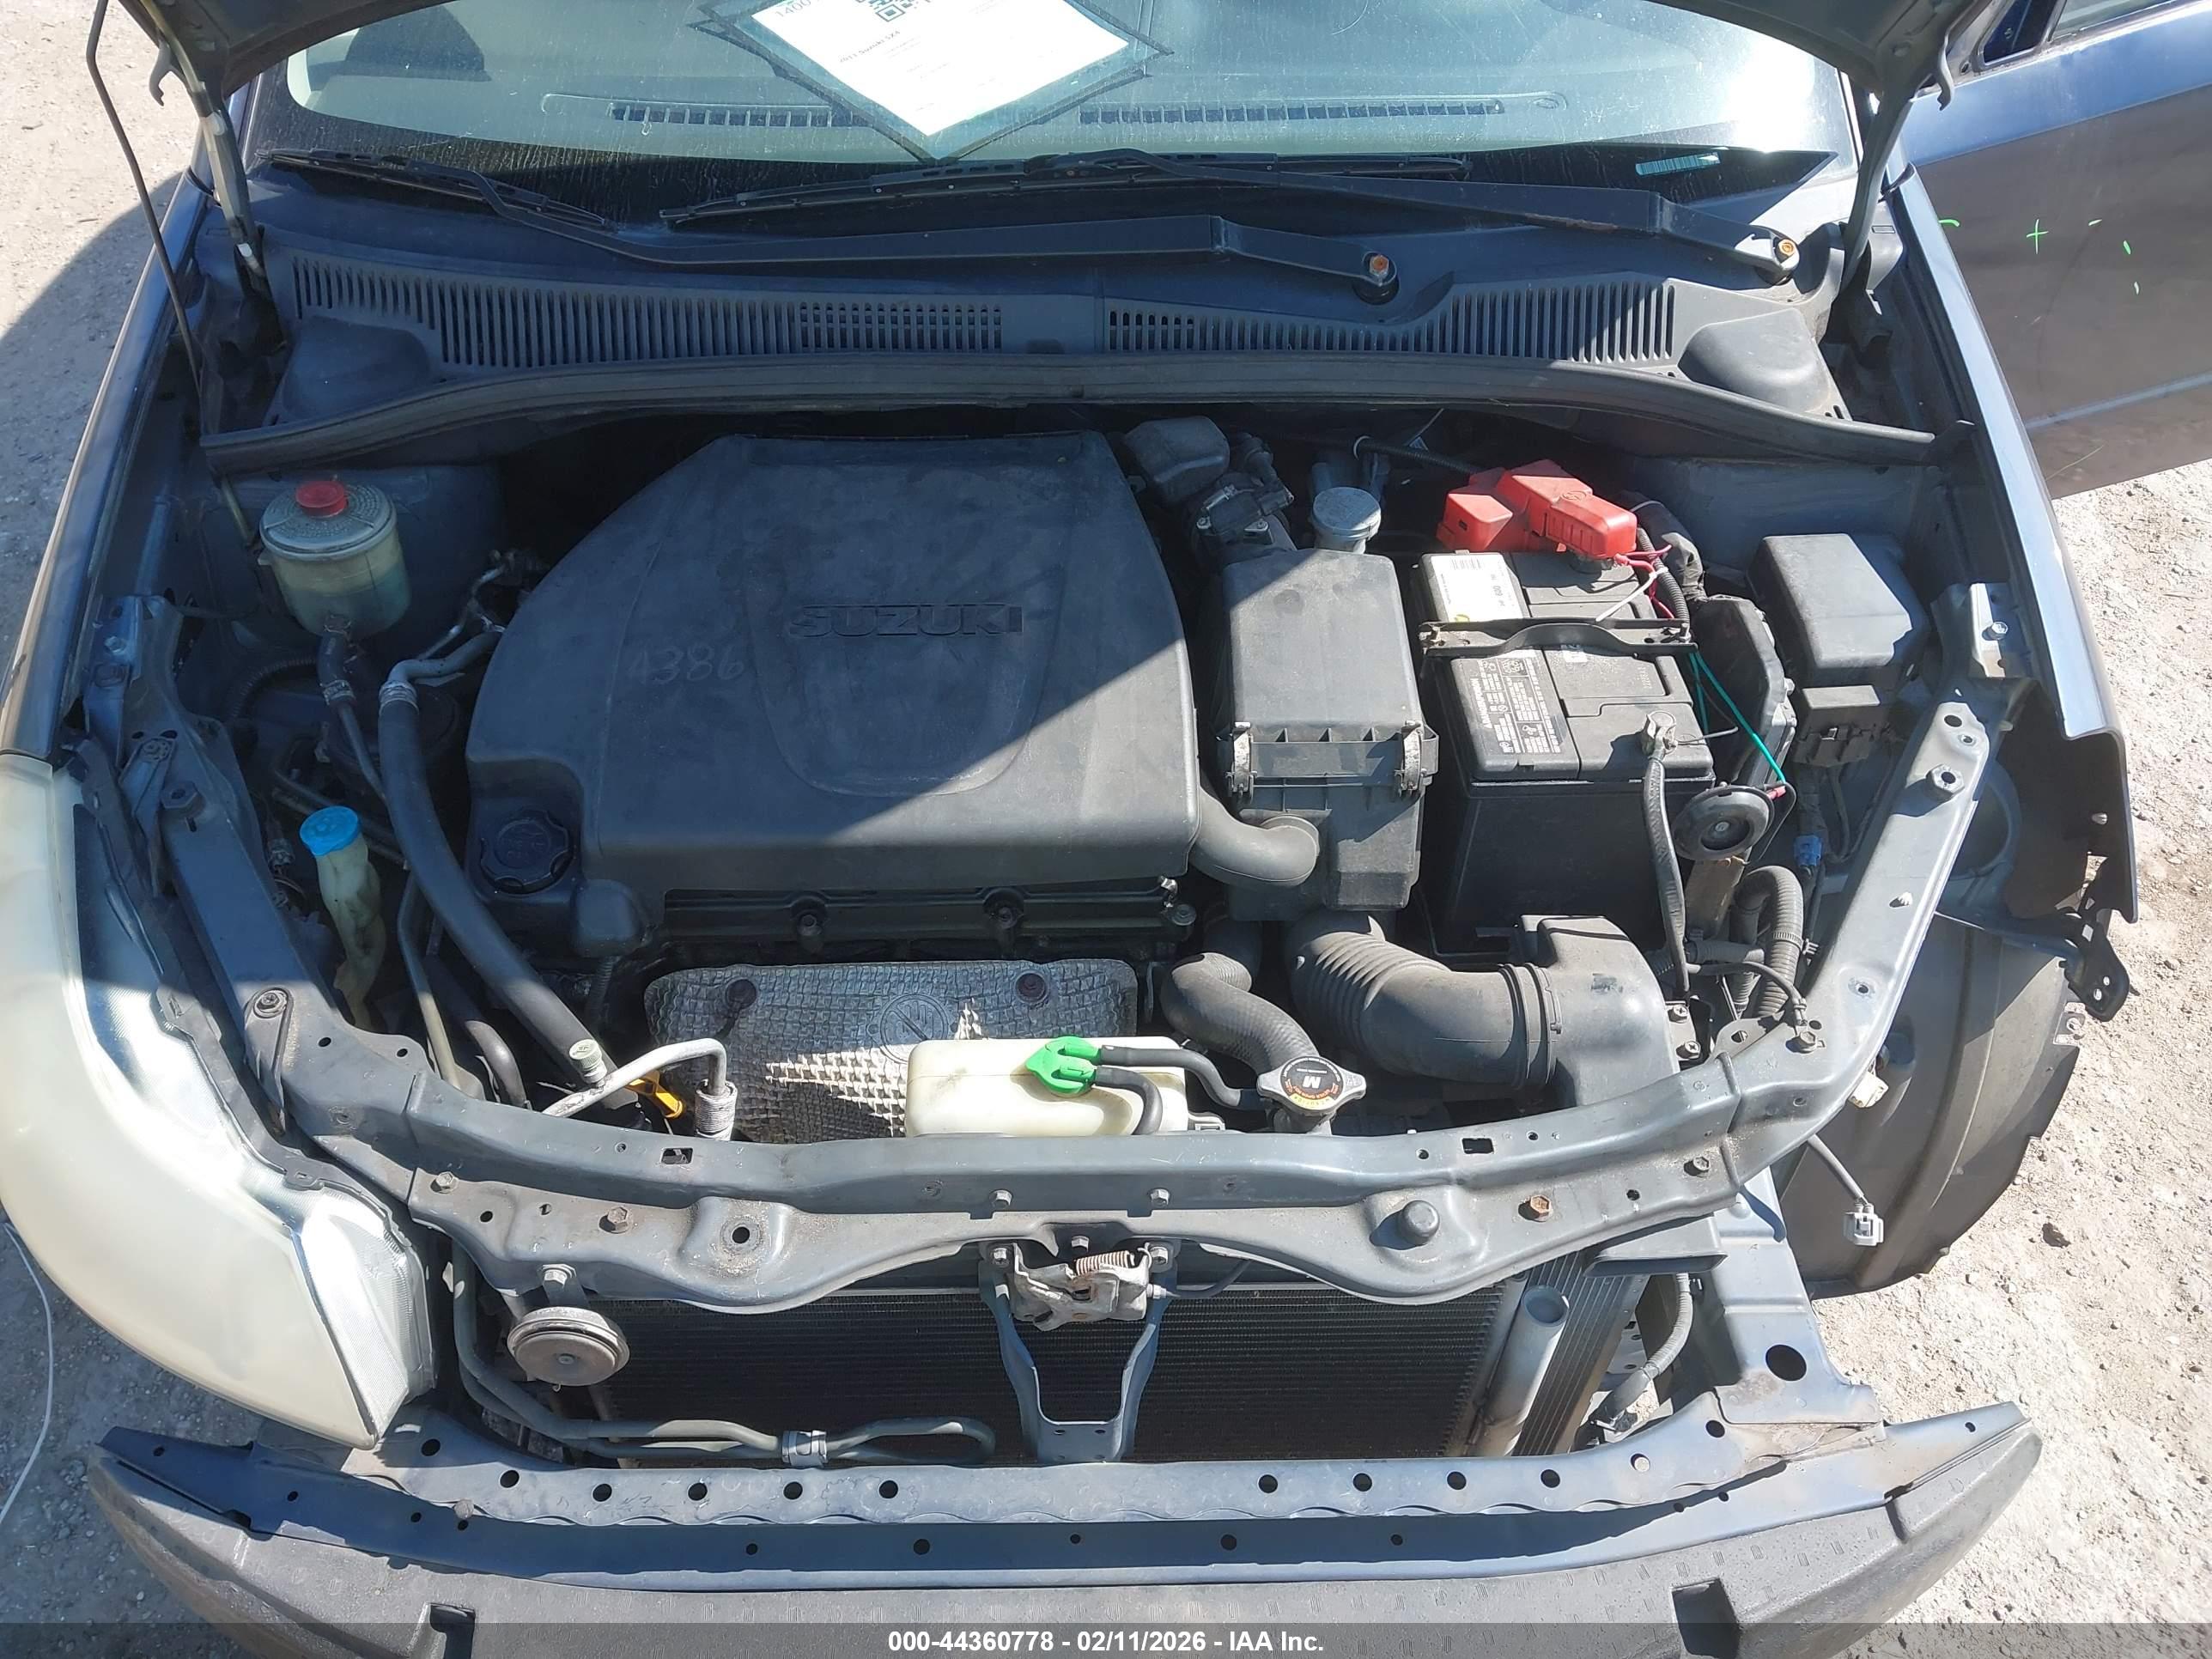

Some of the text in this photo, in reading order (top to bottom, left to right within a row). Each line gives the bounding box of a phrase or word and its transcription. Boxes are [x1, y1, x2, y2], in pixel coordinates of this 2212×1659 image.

[859, 39, 885, 54] Suzuki
[884, 29, 901, 40] SX4
[788, 603, 1024, 637] SUZUKI
